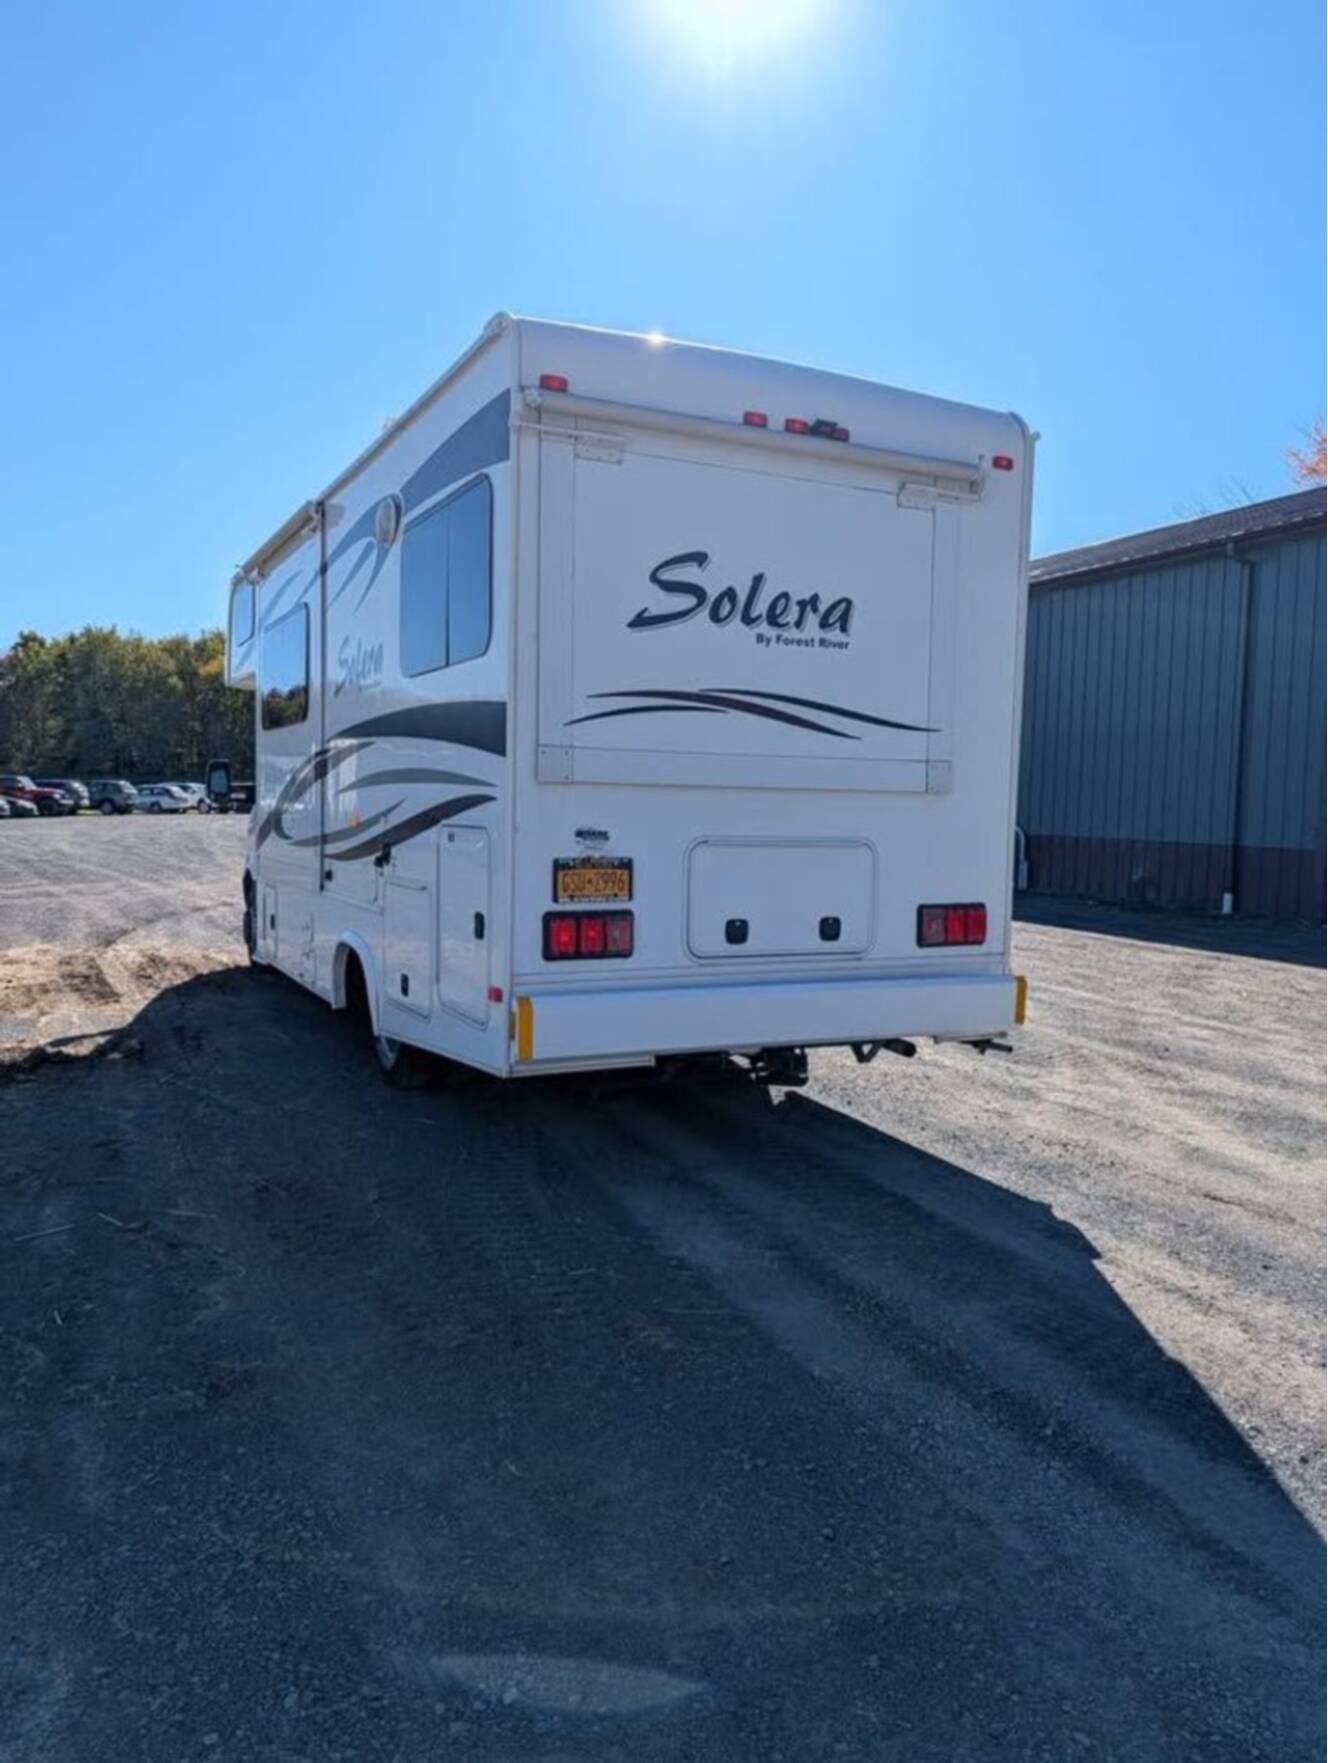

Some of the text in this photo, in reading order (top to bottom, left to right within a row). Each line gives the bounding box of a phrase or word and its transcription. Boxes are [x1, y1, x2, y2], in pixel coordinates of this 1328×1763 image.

[626, 551, 854, 633] Solera
[333, 634, 384, 698] Solera
[756, 633, 850, 650] By Forest River
